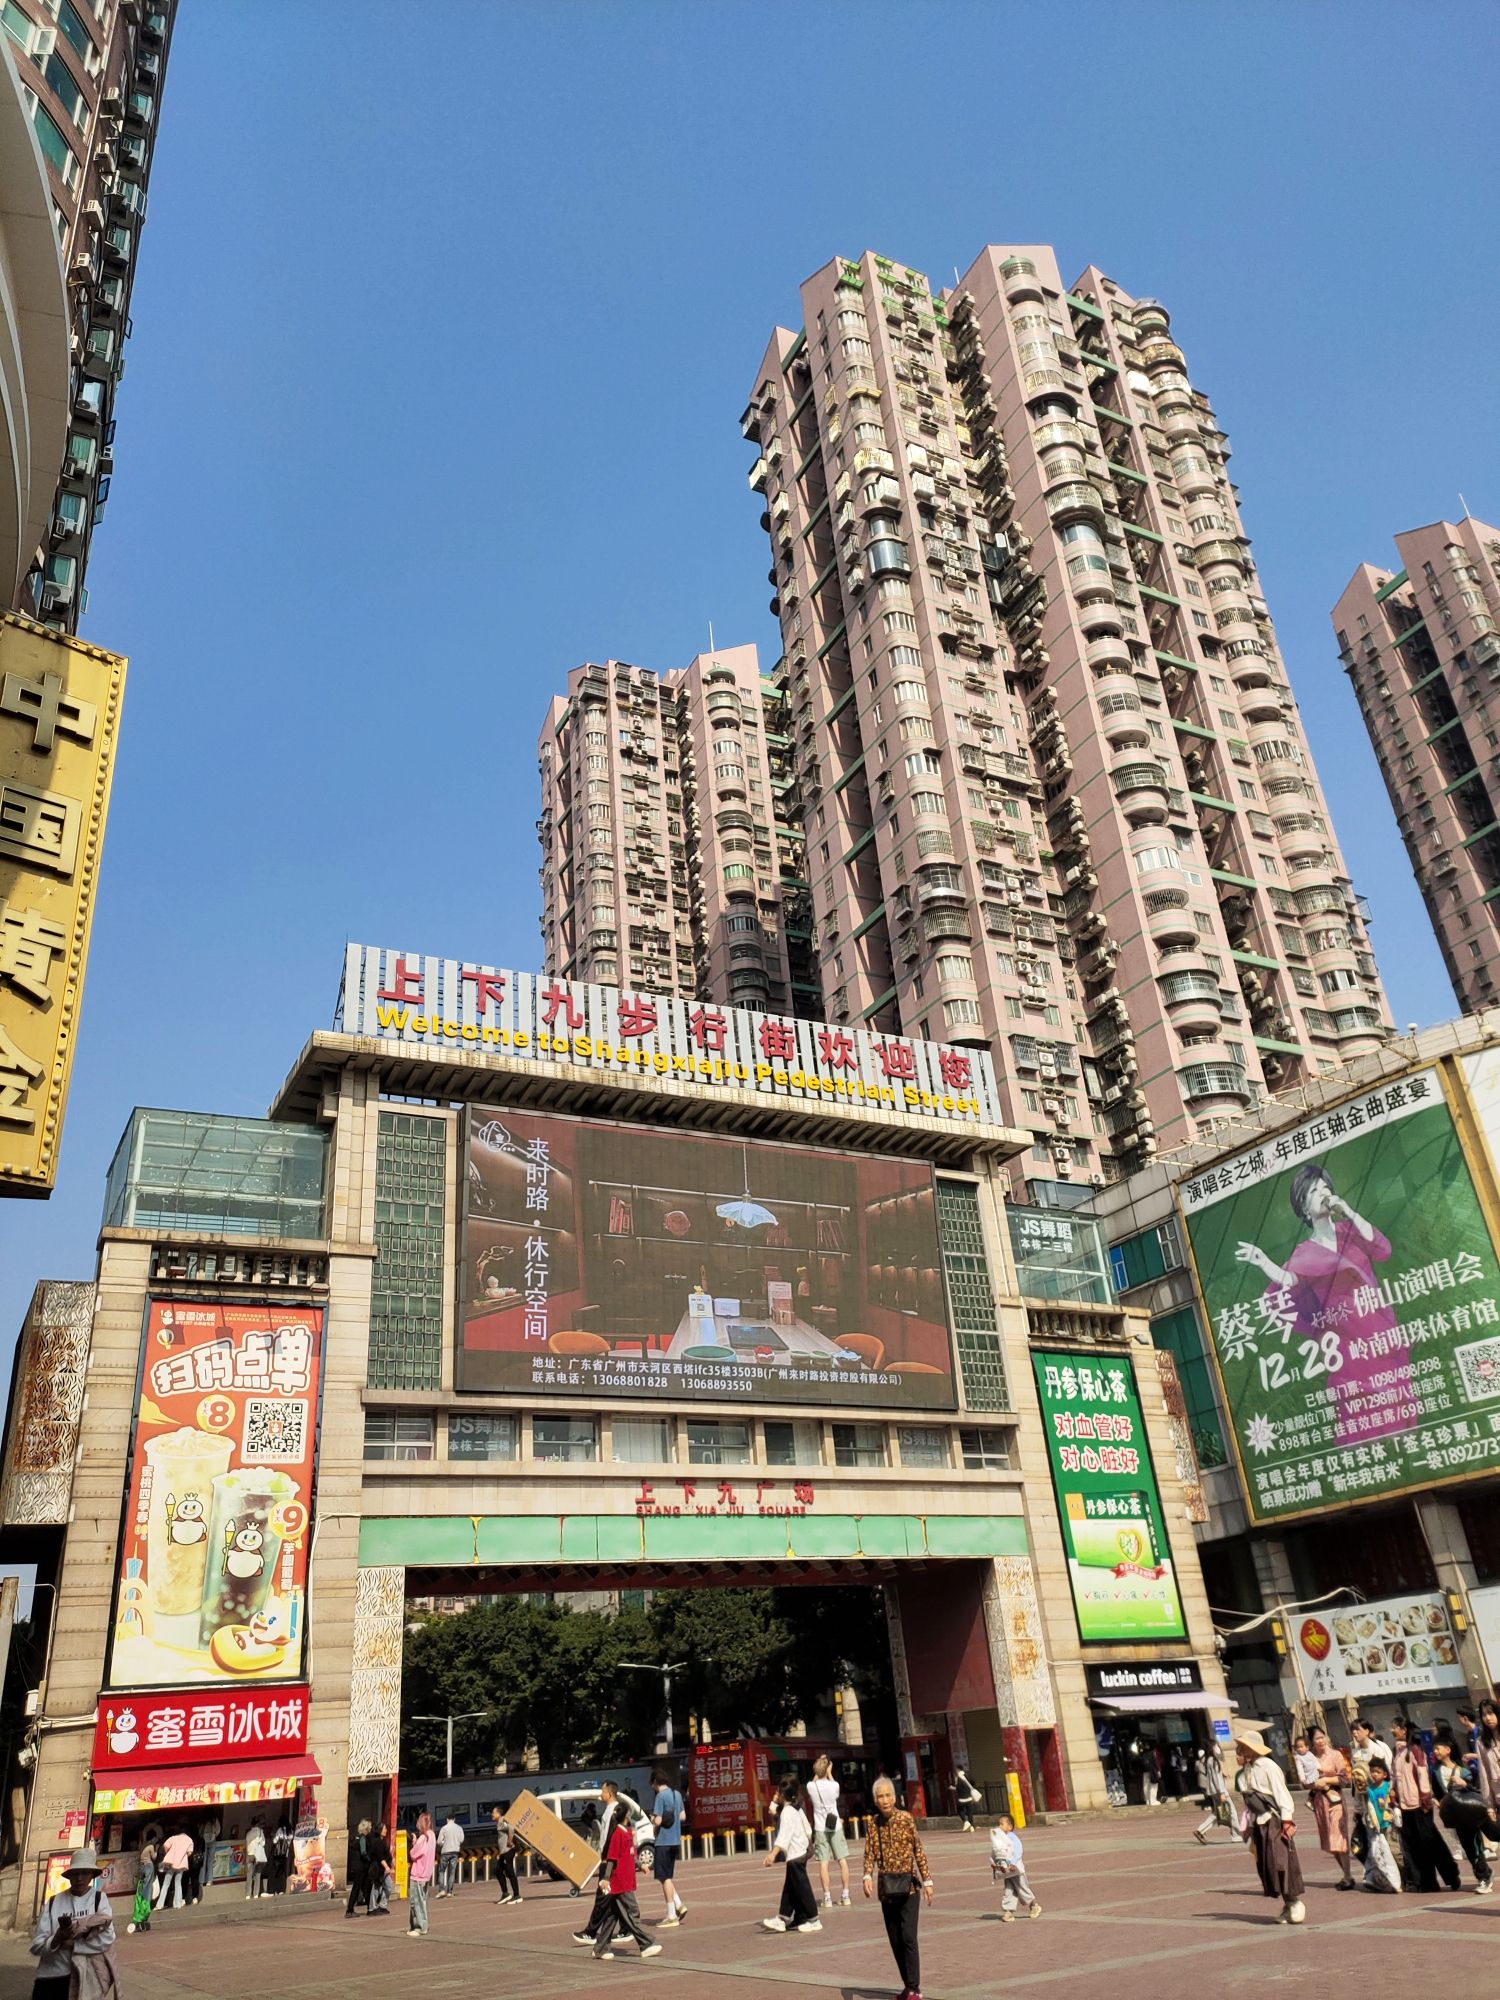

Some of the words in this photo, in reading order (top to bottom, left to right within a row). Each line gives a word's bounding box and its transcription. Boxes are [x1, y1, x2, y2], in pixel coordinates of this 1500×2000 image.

[377, 959, 970, 1089] 上下九步行街欢迎您
[376, 1006, 529, 1047] Welcome
[757, 1064, 895, 1102] Pedestrian
[903, 1086, 981, 1116] Street
[1187, 1150, 1265, 1204] 演唱会之城
[1275, 1076, 1431, 1162] 年度压轴金曲盛宴
[1212, 1285, 1298, 1364] 蔡琴
[1353, 1251, 1485, 1318] 佛山演唱会
[1348, 1298, 1500, 1362] 岭南明珠体育馆
[153, 1327, 312, 1396] 扫码点单
[681, 1378, 752, 1392] 13068893550
[1045, 1366, 1128, 1403] 丹参保心茶
[208, 1401, 230, 1427] 8
[1053, 1411, 1133, 1441] 对血管好
[1059, 1444, 1140, 1474] 对心脏好
[635, 1479, 815, 1505] 上下九广场
[283, 1505, 304, 1533] 9
[635, 1505, 681, 1517] SHANG
[696, 1505, 717, 1516] XIA
[726, 1505, 744, 1516] JIU
[758, 1505, 807, 1517] SQUARE
[1100, 1669, 1138, 1687] luckin
[1139, 1668, 1177, 1686] coffee
[145, 1698, 302, 1750] 蜜雪冰城
[694, 1754, 744, 1773] 美云口腔
[694, 1770, 745, 1789] 专注种牙
